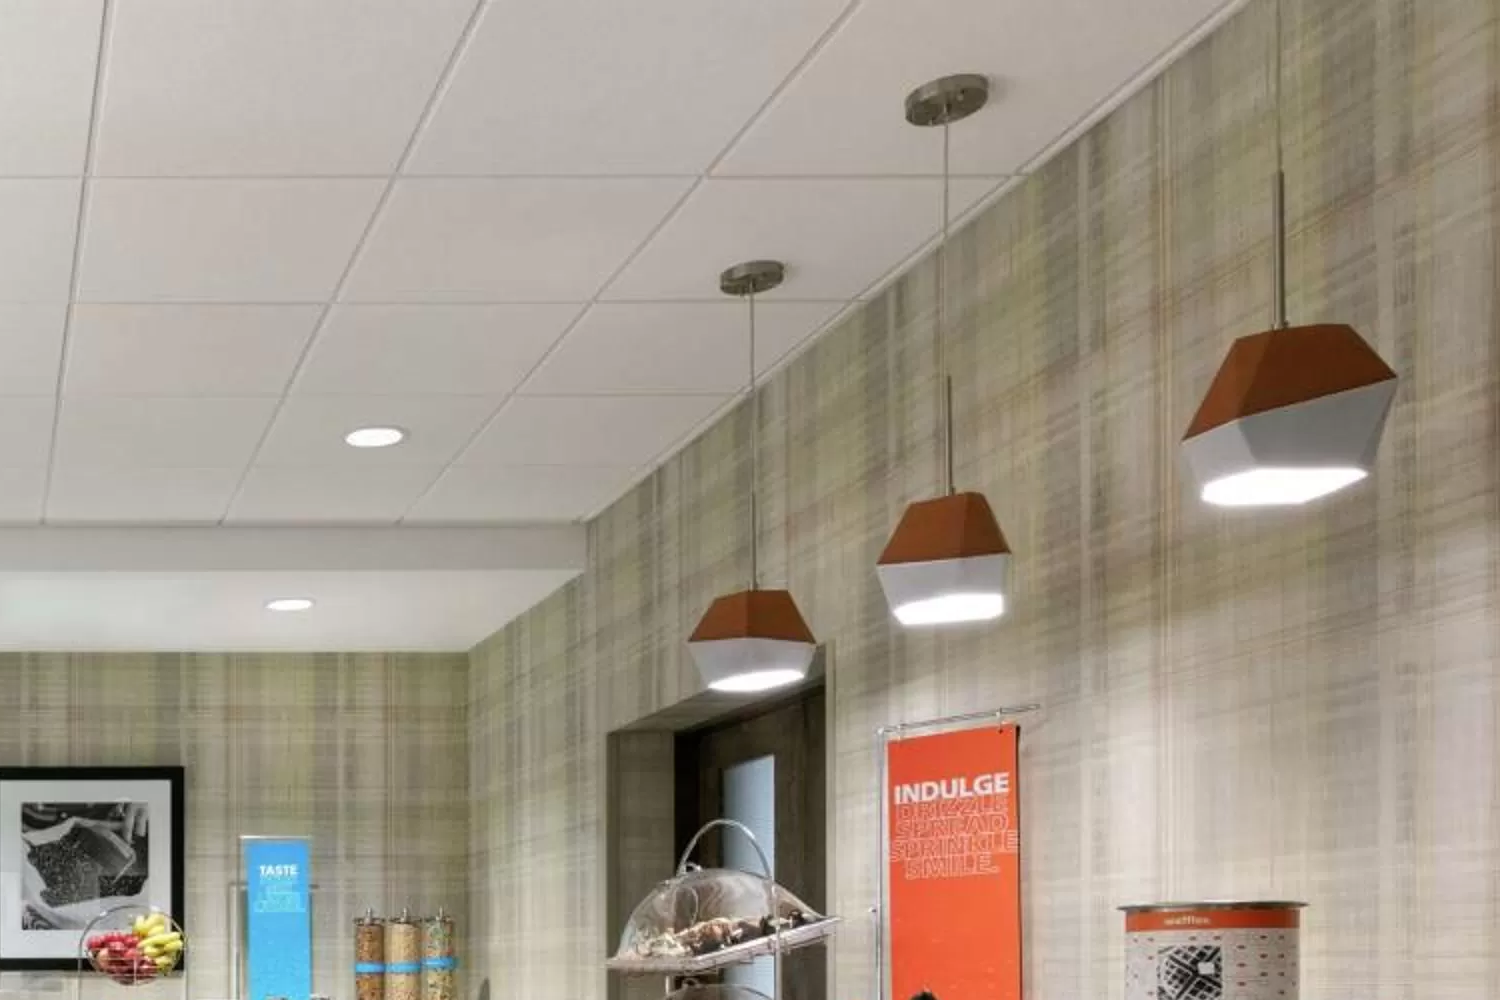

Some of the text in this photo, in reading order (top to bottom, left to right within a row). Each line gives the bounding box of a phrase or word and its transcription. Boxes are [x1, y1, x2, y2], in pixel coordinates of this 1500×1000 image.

[894, 772, 1010, 805] INDULGE
[895, 796, 1008, 821] DRIZZLE
[895, 812, 1009, 840] SPREAD
[890, 828, 1019, 862] SPRINKLE
[259, 864, 299, 876] TASTE
